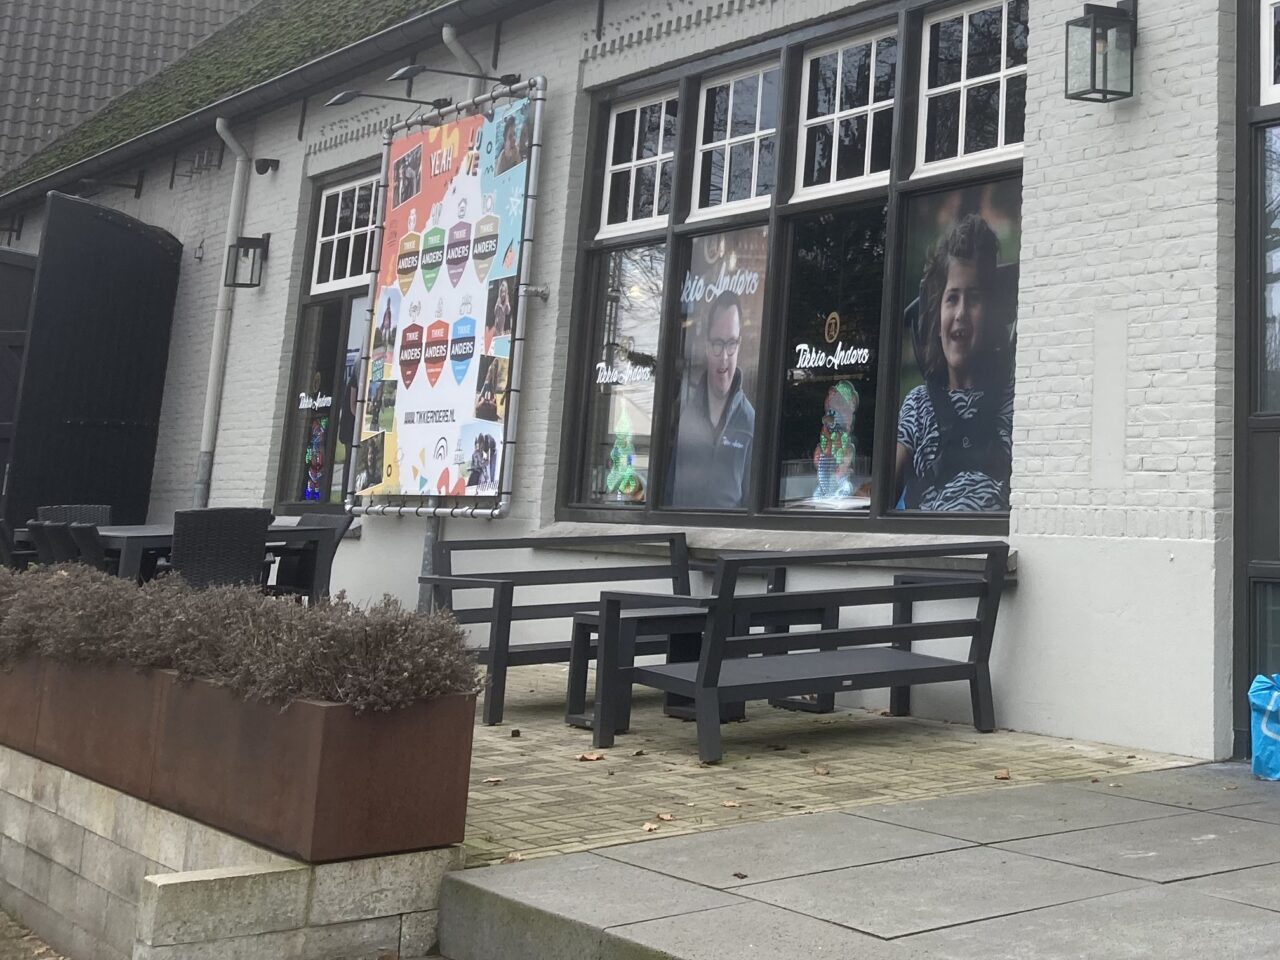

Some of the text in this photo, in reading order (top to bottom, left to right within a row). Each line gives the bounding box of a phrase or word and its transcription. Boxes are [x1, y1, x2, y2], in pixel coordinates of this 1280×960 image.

[430, 144, 453, 177] YEAH
[446, 245, 470, 260] ANDERS
[473, 239, 497, 254] ANDERS
[398, 256, 418, 269] ANDERS
[421, 251, 443, 265] ANDERS
[705, 261, 759, 303] Anders
[400, 347, 421, 361] ANDERS
[424, 345, 447, 358] ANDERS
[451, 341, 474, 356] ANDERS
[795, 341, 870, 370] Tikkie Anders
[596, 362, 618, 384] Tikkie
